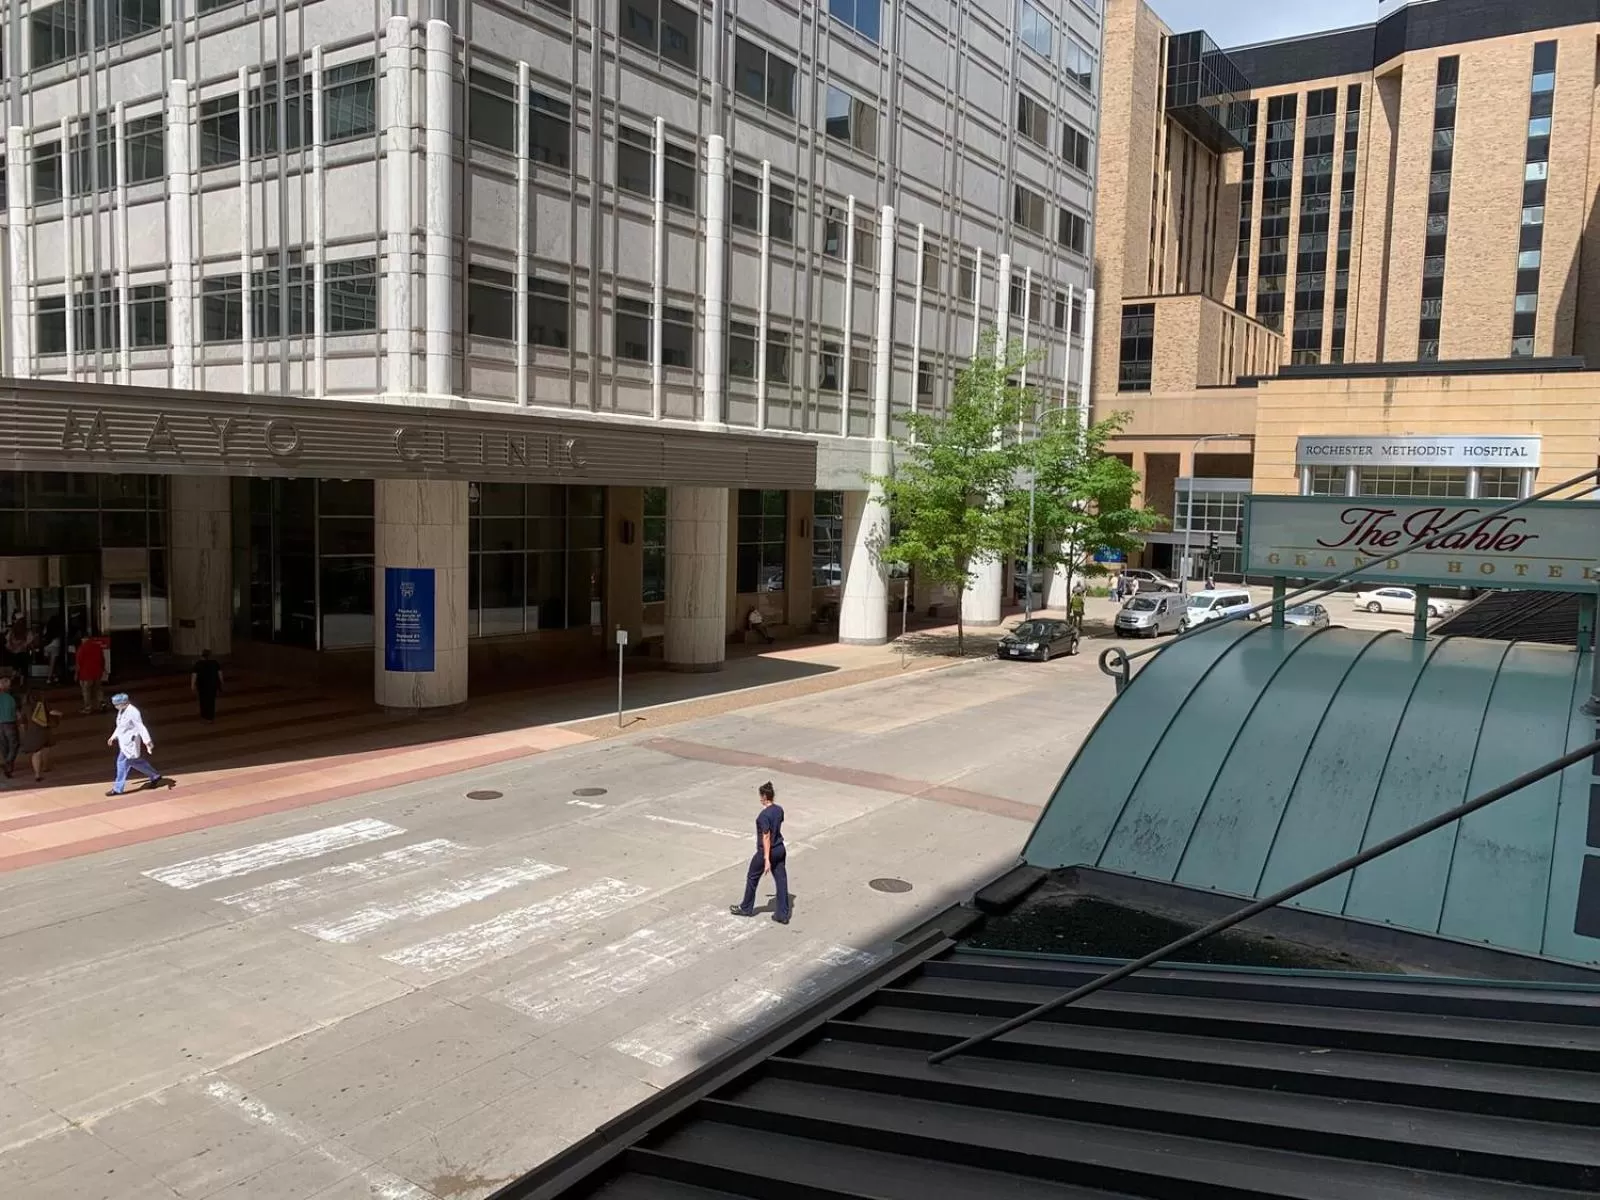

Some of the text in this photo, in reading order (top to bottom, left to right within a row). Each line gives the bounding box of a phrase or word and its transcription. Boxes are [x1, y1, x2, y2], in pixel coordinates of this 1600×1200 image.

[60, 407, 588, 468] MAYO CLINIC
[1306, 445, 1529, 457] ROCHESTER METHODIST HOSPITAL
[1317, 507, 1539, 551] The Kahler
[1268, 552, 1597, 579] GRAND HOTEL
